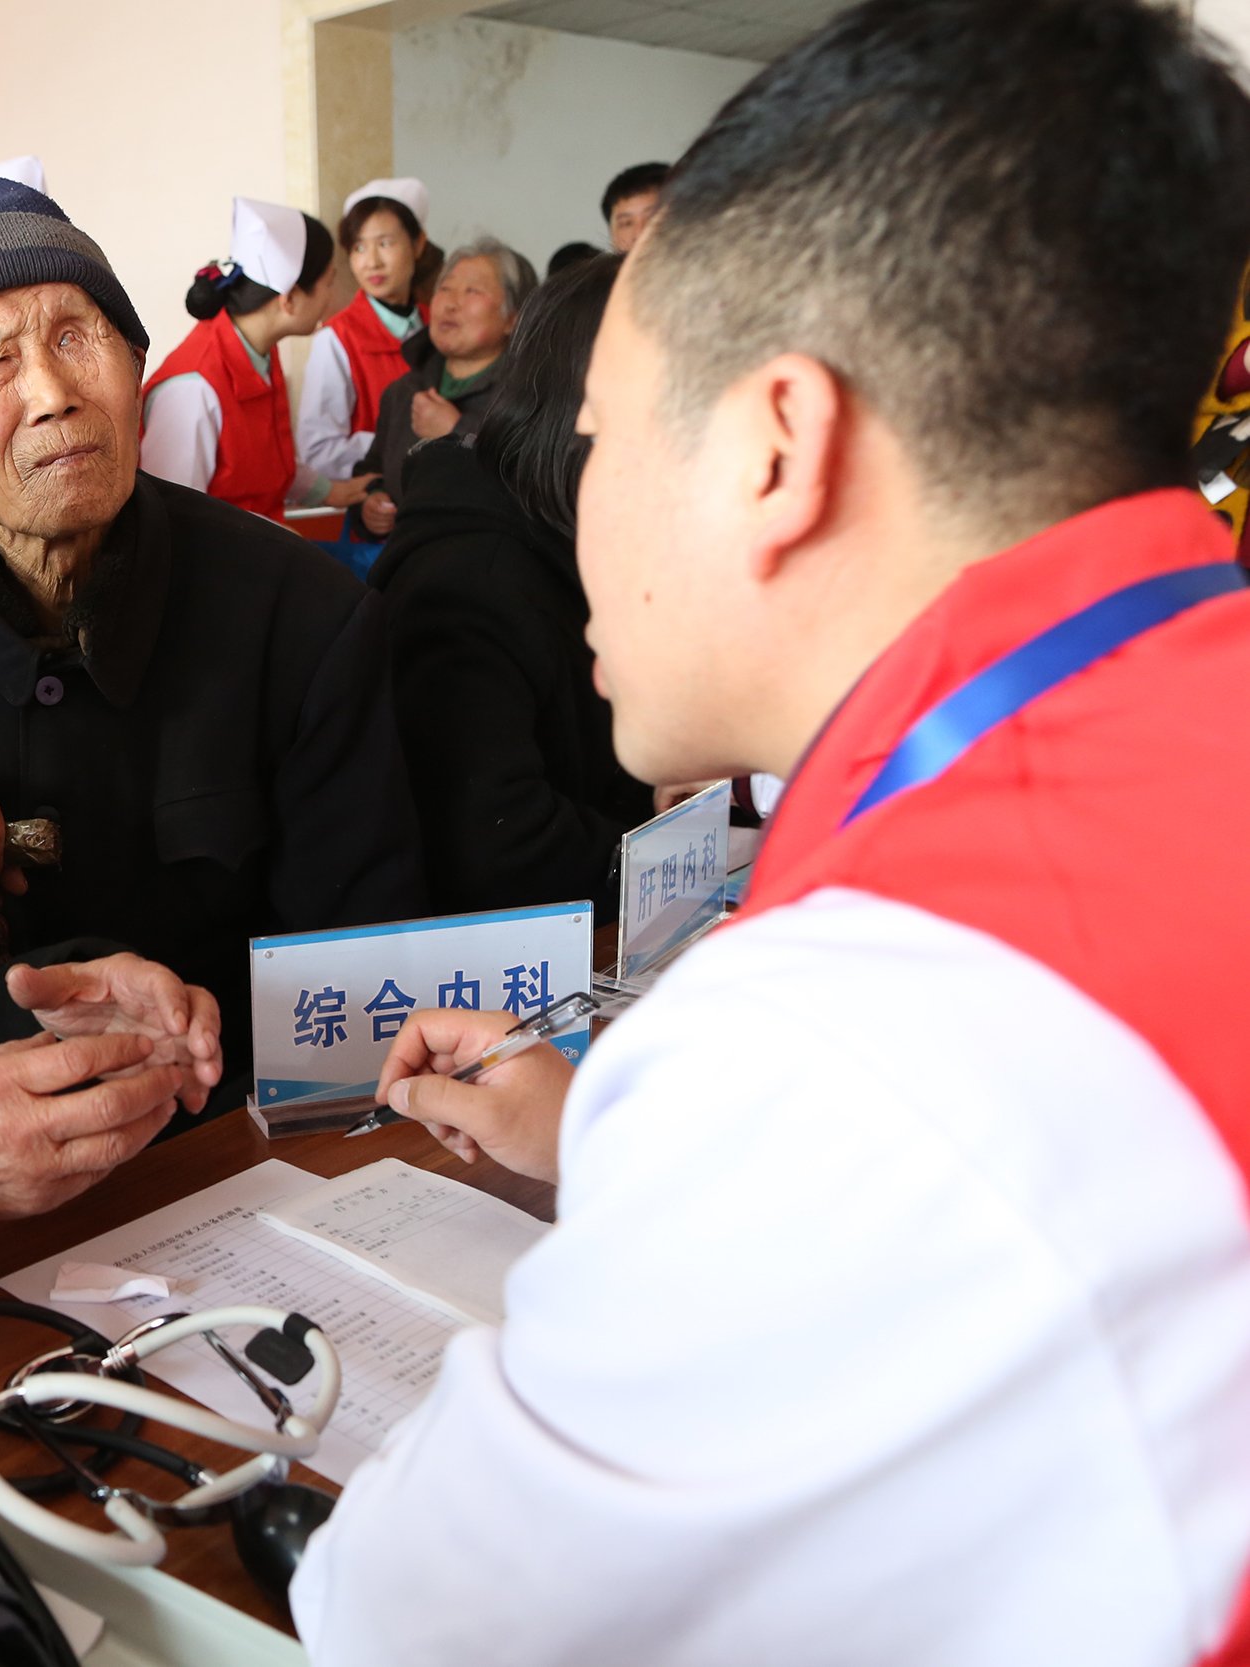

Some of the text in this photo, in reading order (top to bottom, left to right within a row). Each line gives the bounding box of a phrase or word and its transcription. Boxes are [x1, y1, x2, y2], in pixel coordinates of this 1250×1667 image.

[637, 827, 717, 923] 肝胆内科
[293, 960, 555, 1048] 综合内科
